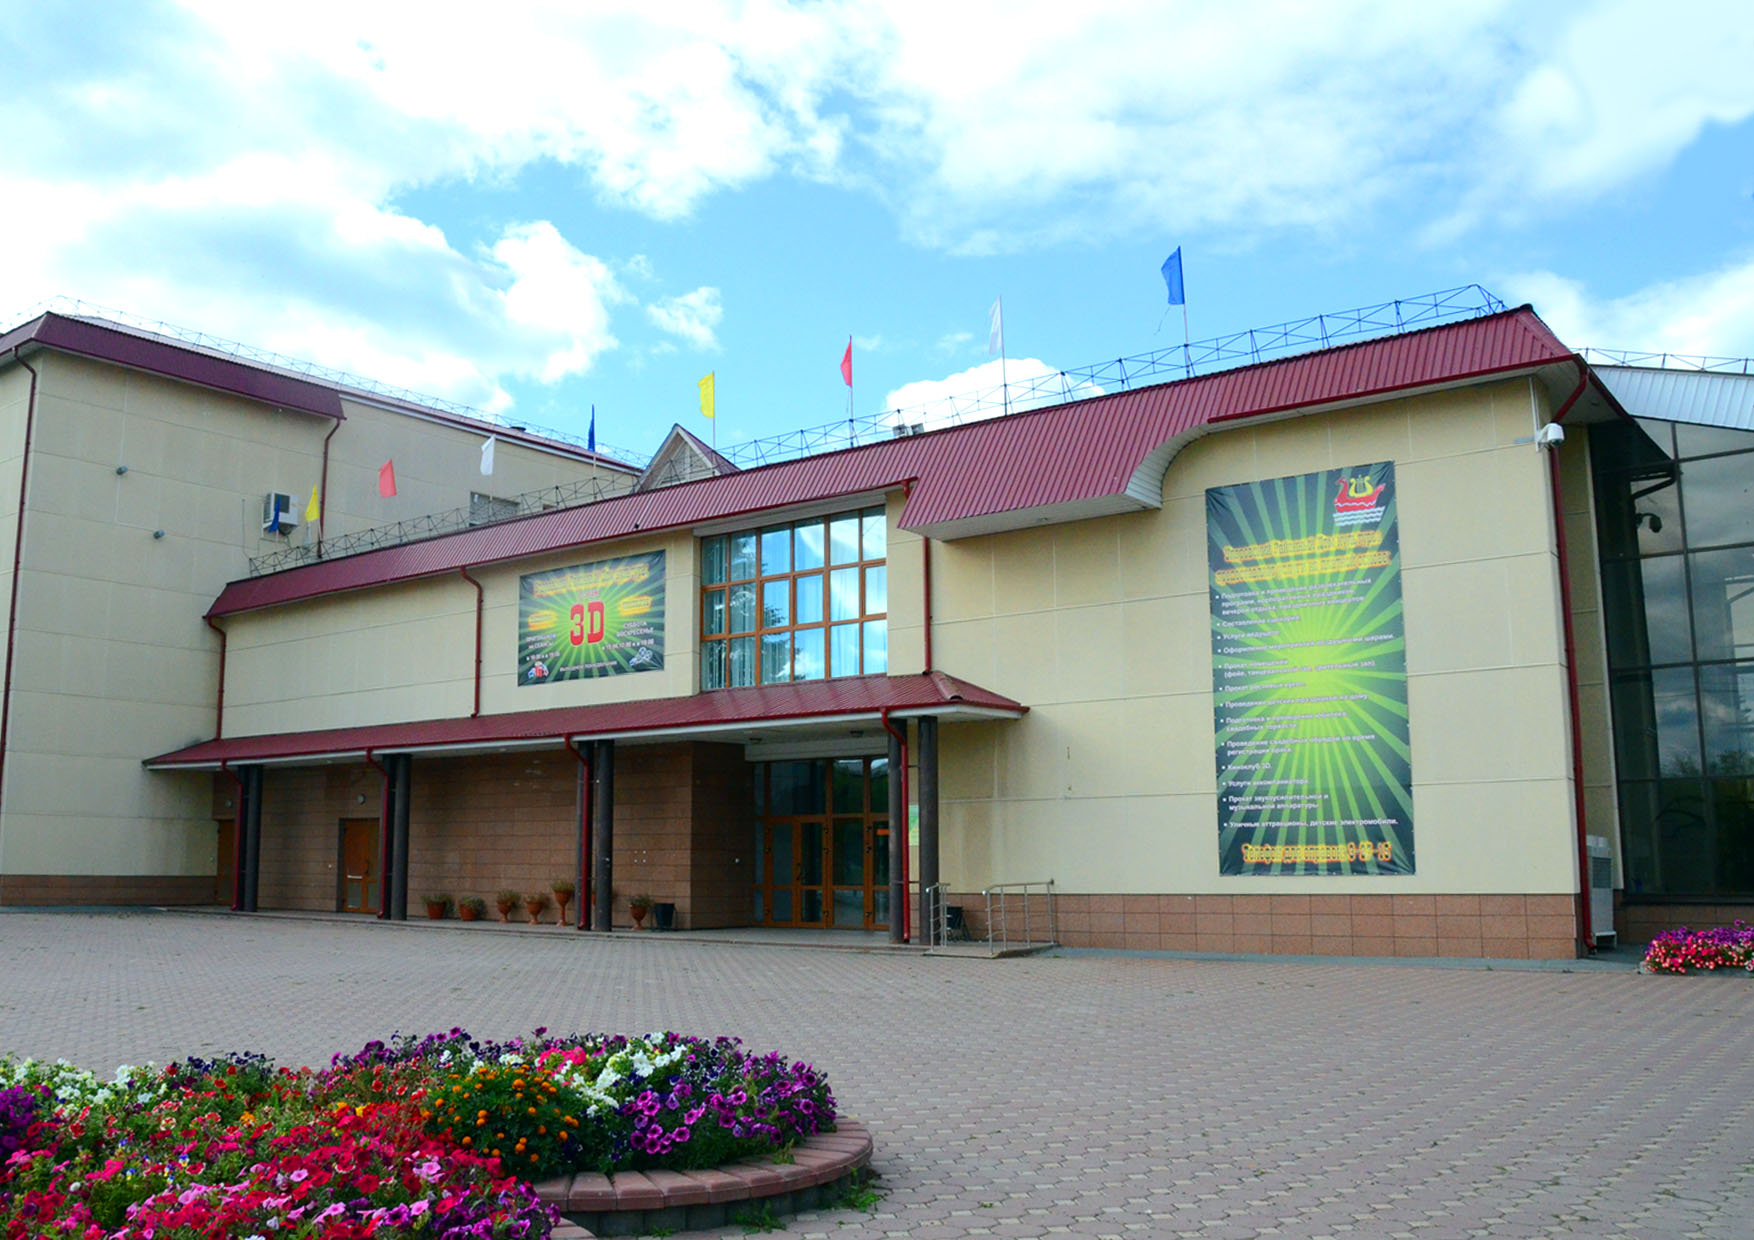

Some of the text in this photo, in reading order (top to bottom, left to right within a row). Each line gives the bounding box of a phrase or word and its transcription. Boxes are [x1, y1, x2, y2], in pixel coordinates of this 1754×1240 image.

[570, 601, 604, 646] 3D
[1242, 843, 1282, 864] Телефон
[1282, 845, 1304, 863] для
